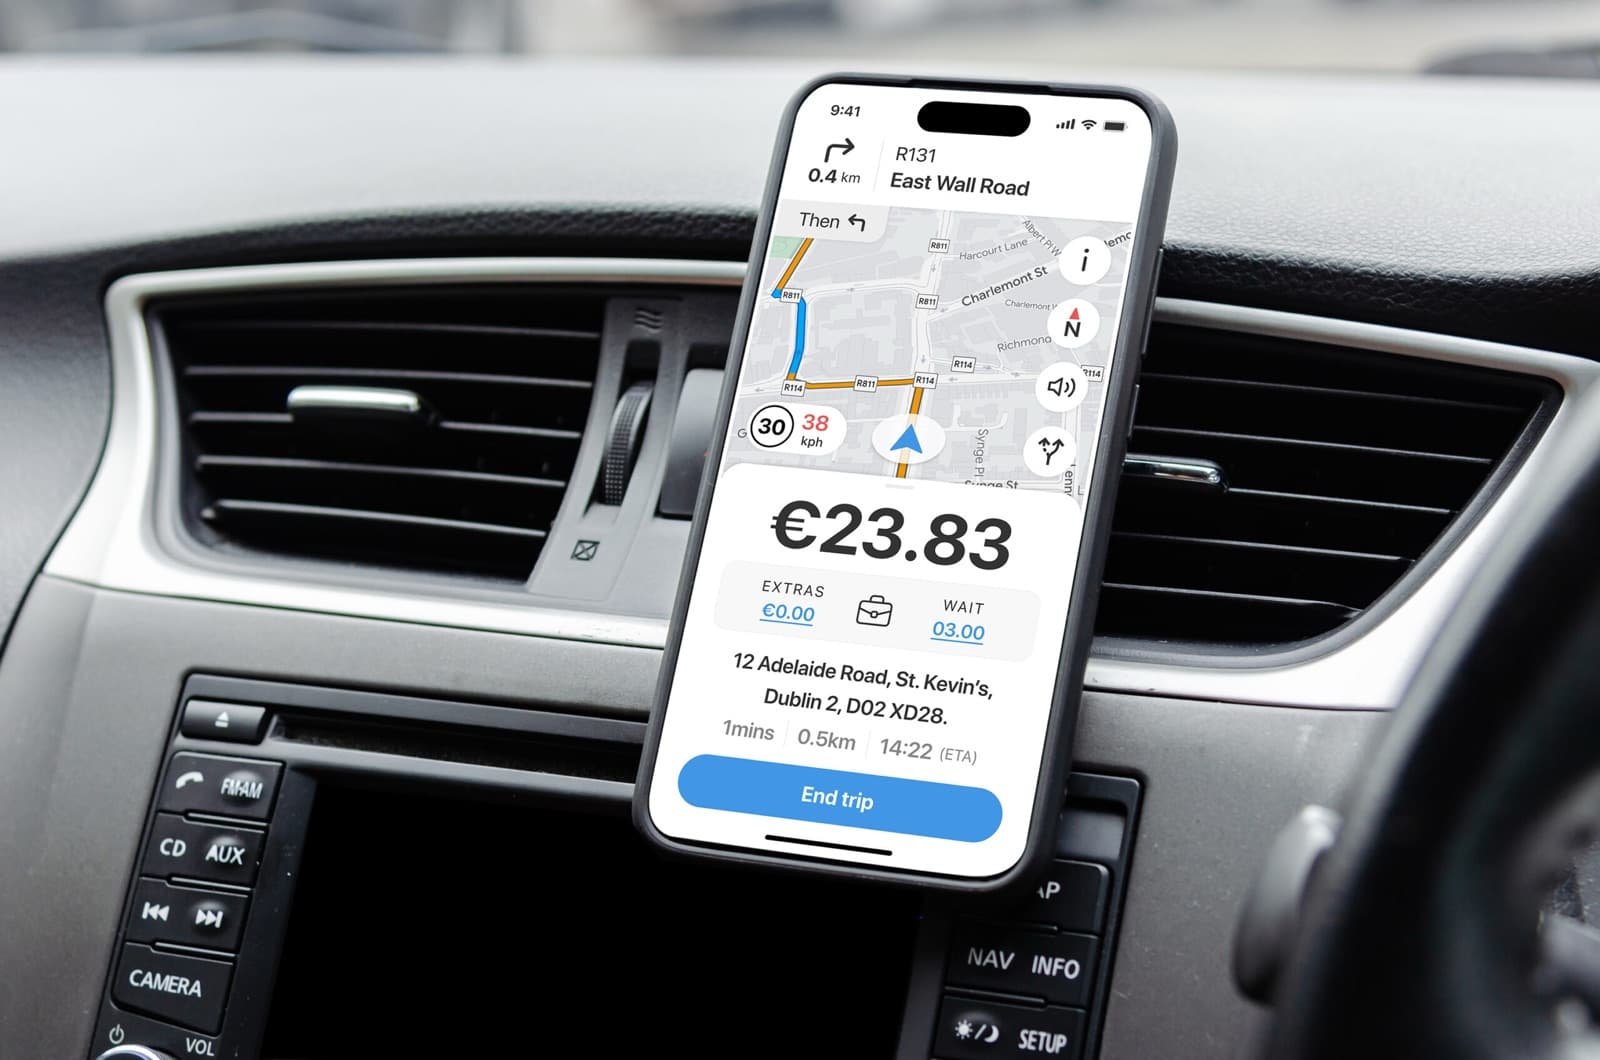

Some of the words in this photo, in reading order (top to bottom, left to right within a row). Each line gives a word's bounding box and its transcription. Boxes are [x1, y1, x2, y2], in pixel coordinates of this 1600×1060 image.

[830, 104, 861, 117] 9:41
[895, 146, 936, 163] R131
[808, 168, 837, 184] 0.4
[840, 171, 861, 184] km
[890, 172, 932, 190] East
[937, 175, 977, 193] Wall
[979, 177, 1030, 197] Road
[799, 212, 840, 229] Then
[1022, 220, 1046, 243] Albert
[930, 241, 948, 251] R811
[959, 245, 1002, 261] Harcourt
[1004, 239, 1029, 252] Lane
[781, 291, 801, 301] R811
[961, 272, 1033, 307] Charlemont
[1034, 265, 1049, 279] St
[918, 297, 937, 307] R811
[1004, 299, 1051, 311] Charlemont
[1063, 320, 1081, 338] N
[953, 359, 973, 369] R114
[783, 383, 803, 393] R114
[856, 379, 876, 389] R811
[915, 375, 935, 385] R114
[757, 418, 786, 436] 30
[801, 413, 829, 432] 38
[800, 436, 823, 449] kph
[973, 428, 989, 464] Synge
[974, 466, 985, 477] Pl
[770, 499, 1013, 571] €23.83
[761, 580, 825, 598] EXTRAS
[761, 602, 816, 622] €0.00
[943, 599, 985, 615] WAIT
[932, 620, 986, 642] 03.00
[733, 653, 755, 670] 12
[757, 656, 837, 679] Adelaide
[840, 664, 892, 688] Road,
[895, 671, 920, 689] St.
[923, 674, 994, 700] Kevin’s,
[763, 688, 822, 710] Dublin
[825, 695, 843, 715] 2,
[846, 697, 887, 717] D02
[889, 702, 948, 725] XD28.
[722, 719, 776, 741] 1mins
[797, 728, 857, 751] 0.5km
[880, 738, 934, 760] 14:22
[939, 747, 978, 766] (ETA)
[801, 786, 838, 807] End
[841, 790, 875, 814] trip
[159, 837, 187, 857] CD
[205, 844, 246, 866] AUX
[967, 946, 1016, 970] NAV
[1031, 954, 1081, 980] INFO
[128, 968, 203, 999] CAMERA
[185, 1036, 215, 1057] VOL
[1017, 1028, 1068, 1055] SETUP
